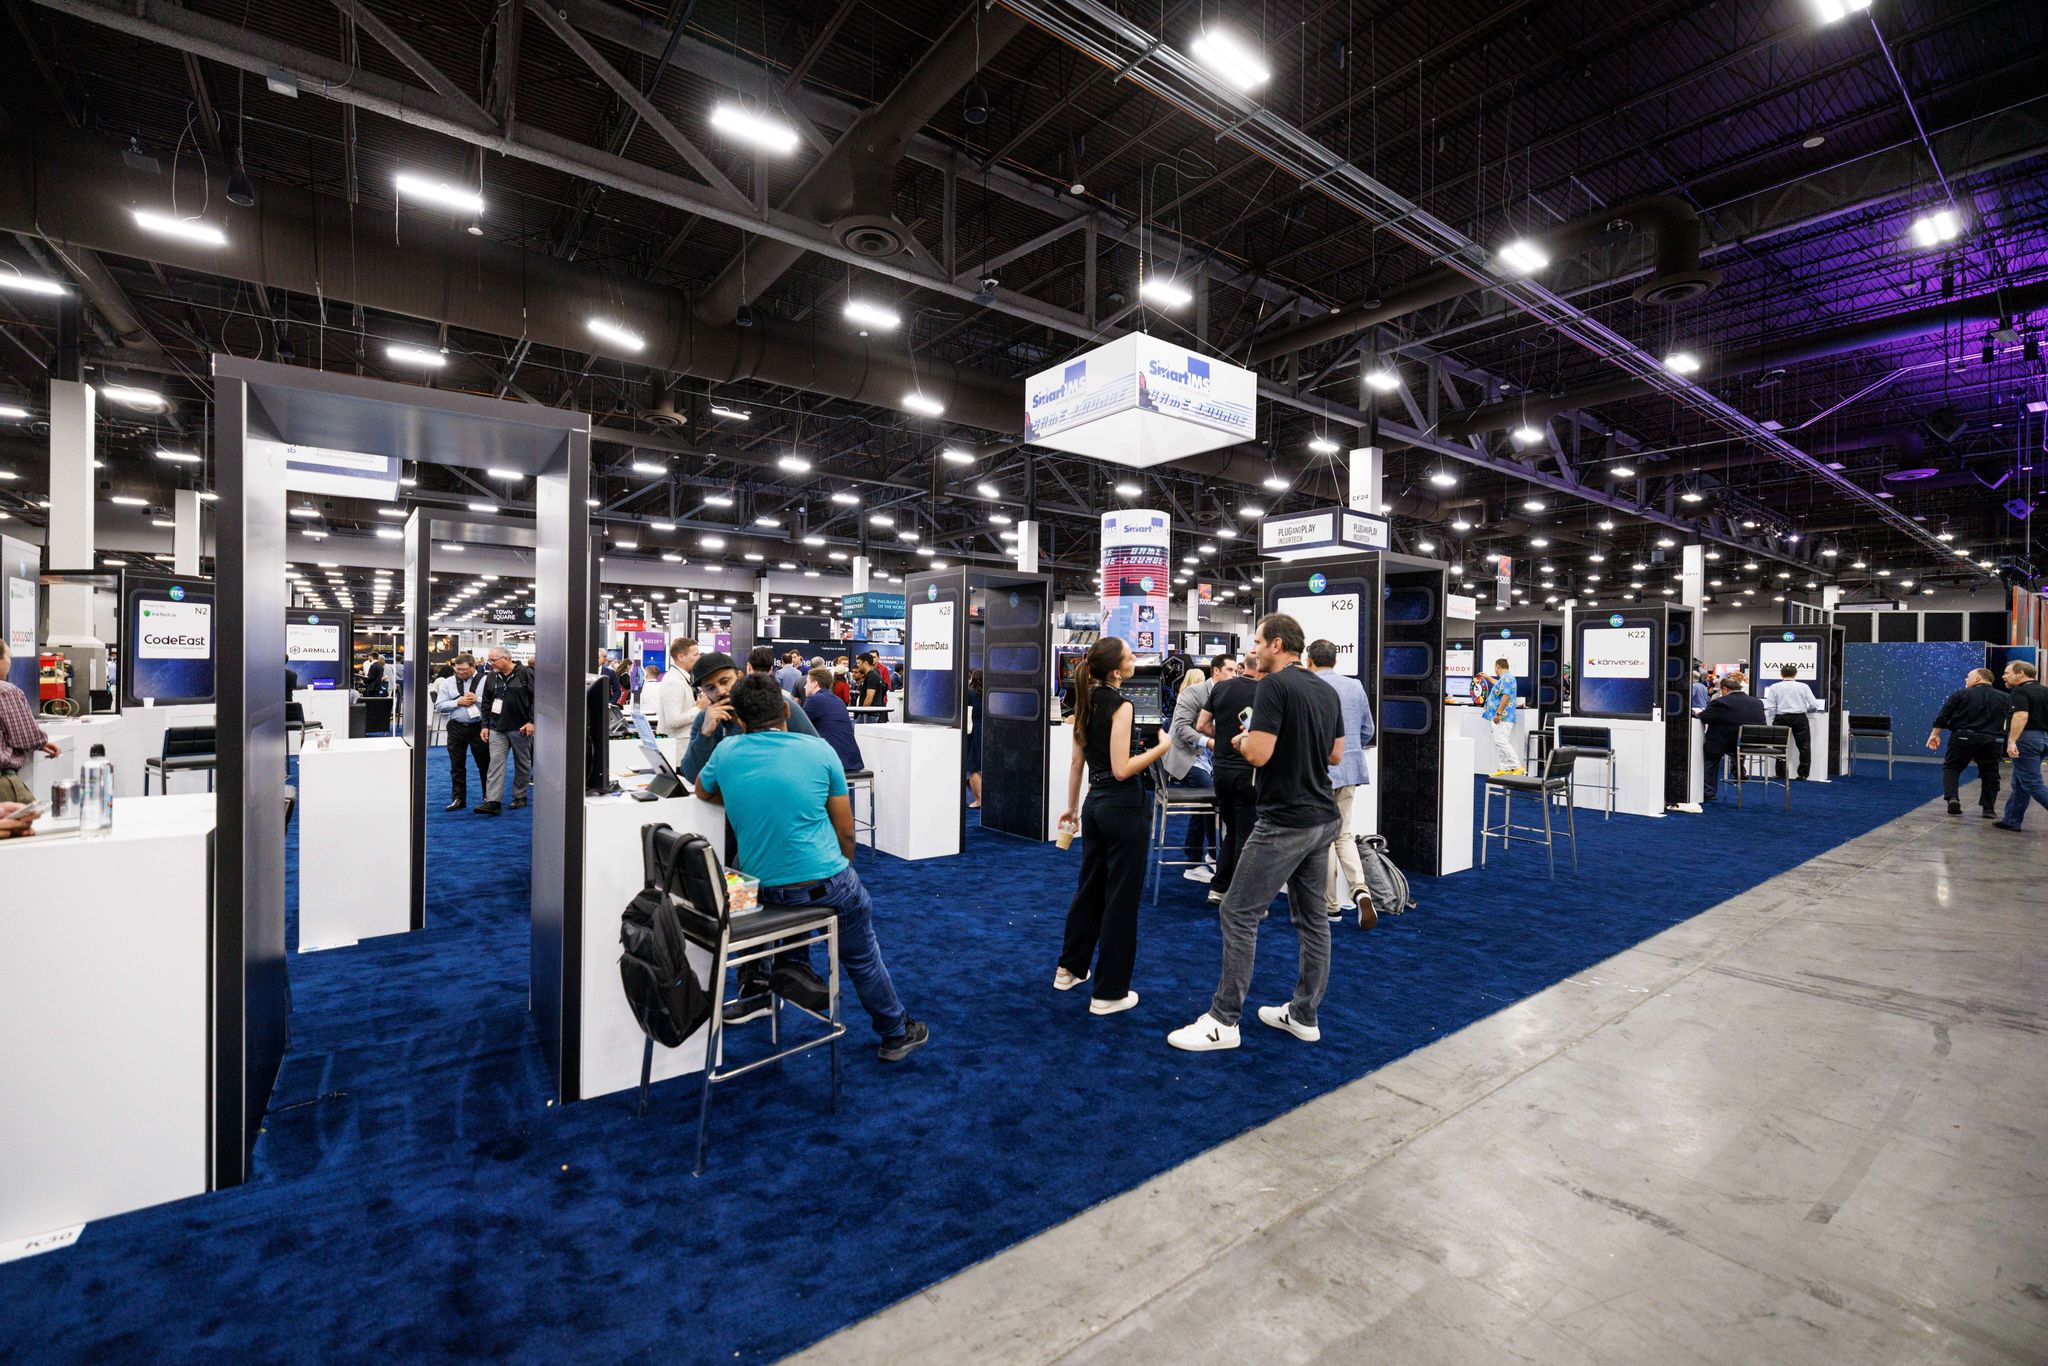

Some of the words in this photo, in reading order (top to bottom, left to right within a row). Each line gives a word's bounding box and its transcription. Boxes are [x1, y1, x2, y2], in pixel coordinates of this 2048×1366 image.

[1130, 547, 1162, 556] GAME
[1123, 555, 1163, 565] LOUNGE
[1311, 579, 1325, 588] ITC
[1331, 600, 1354, 611] K26
[194, 607, 208, 615] N2
[144, 634, 205, 646] CodeEast
